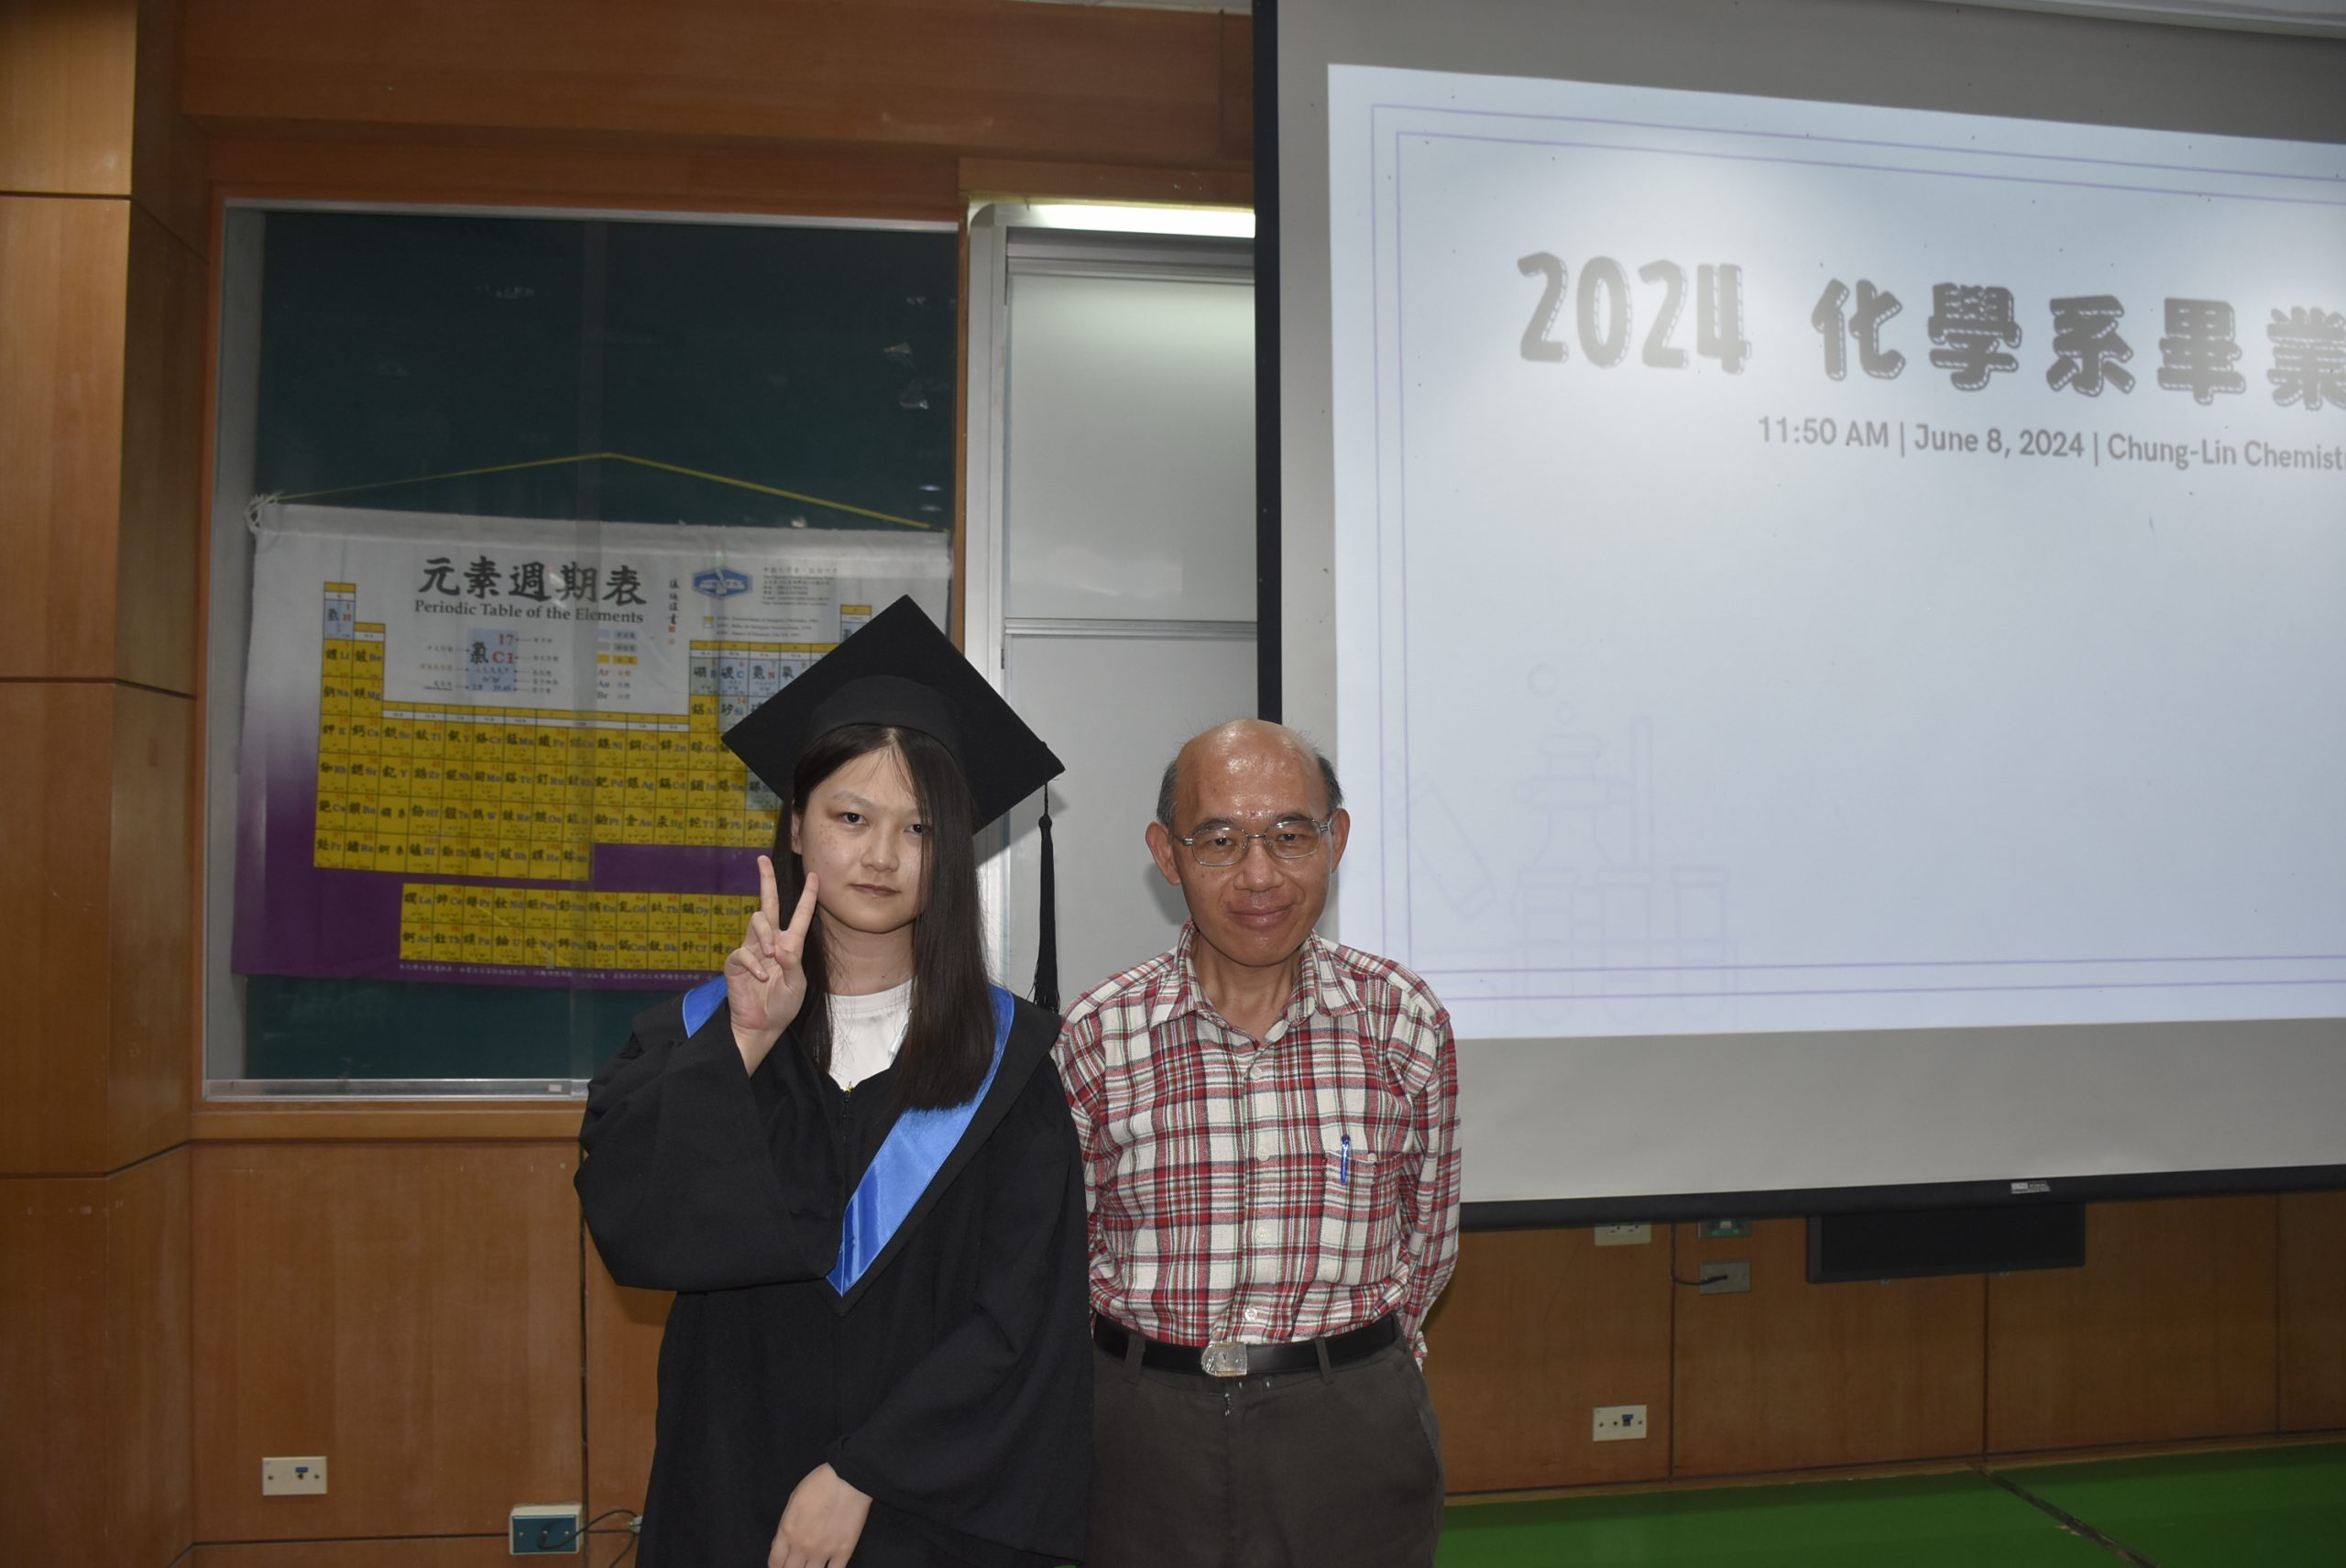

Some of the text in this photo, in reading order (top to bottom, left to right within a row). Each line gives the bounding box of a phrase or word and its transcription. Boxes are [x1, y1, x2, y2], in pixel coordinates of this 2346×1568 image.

[1517, 251, 2346, 411] 2024 化學系畢業
[1758, 415, 1836, 445] 11:50
[1846, 420, 1888, 447] AM
[1914, 423, 1979, 452] June
[1986, 427, 2011, 459] 8,
[2019, 429, 2084, 457] 2024
[2107, 432, 2237, 469] Chung-Lin
[418, 555, 646, 606] 元素週期表
[414, 598, 643, 624] Periodic Table of the Elements
[499, 634, 514, 645] 17
